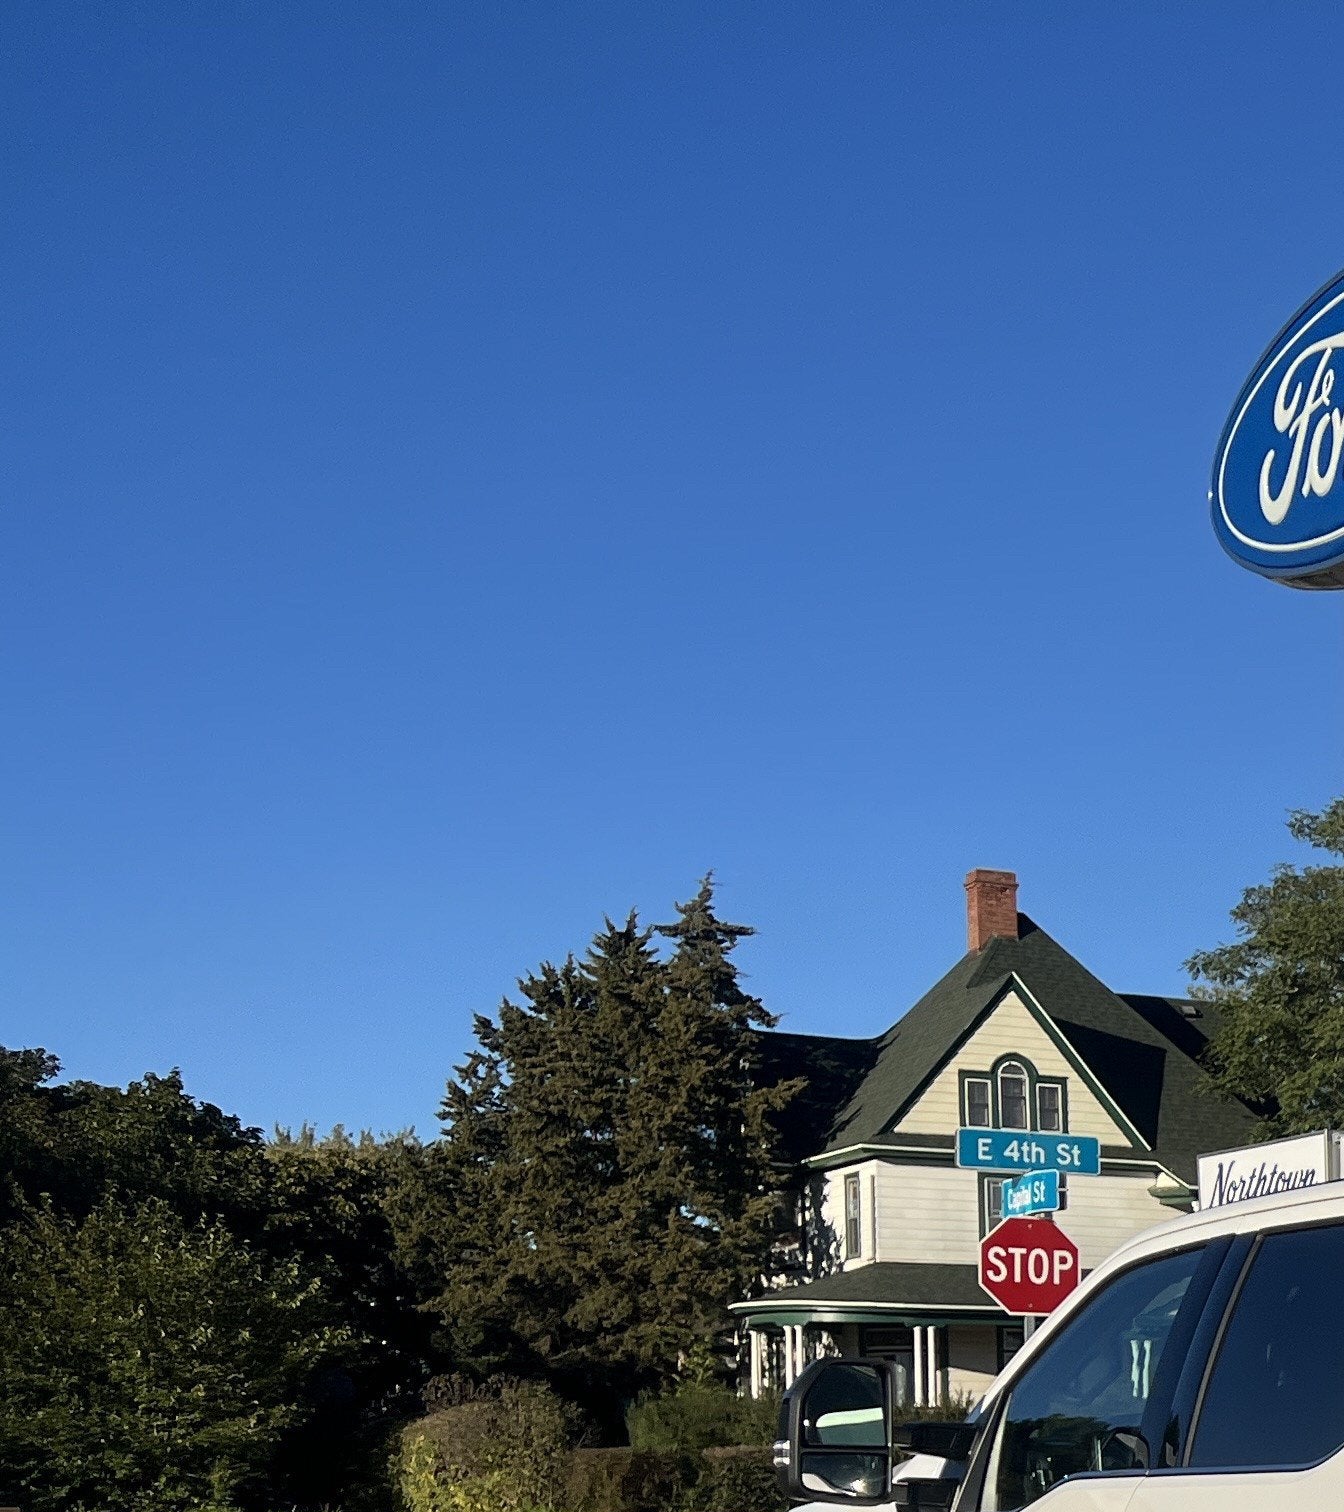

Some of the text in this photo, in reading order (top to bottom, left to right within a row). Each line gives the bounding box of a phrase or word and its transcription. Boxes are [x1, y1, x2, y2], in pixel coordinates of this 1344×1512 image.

[977, 1137, 1082, 1167] E 4th St
[1033, 1180, 1046, 1203] St
[1208, 1160, 1316, 1209] Northtown
[986, 1245, 1074, 1286] STOP
